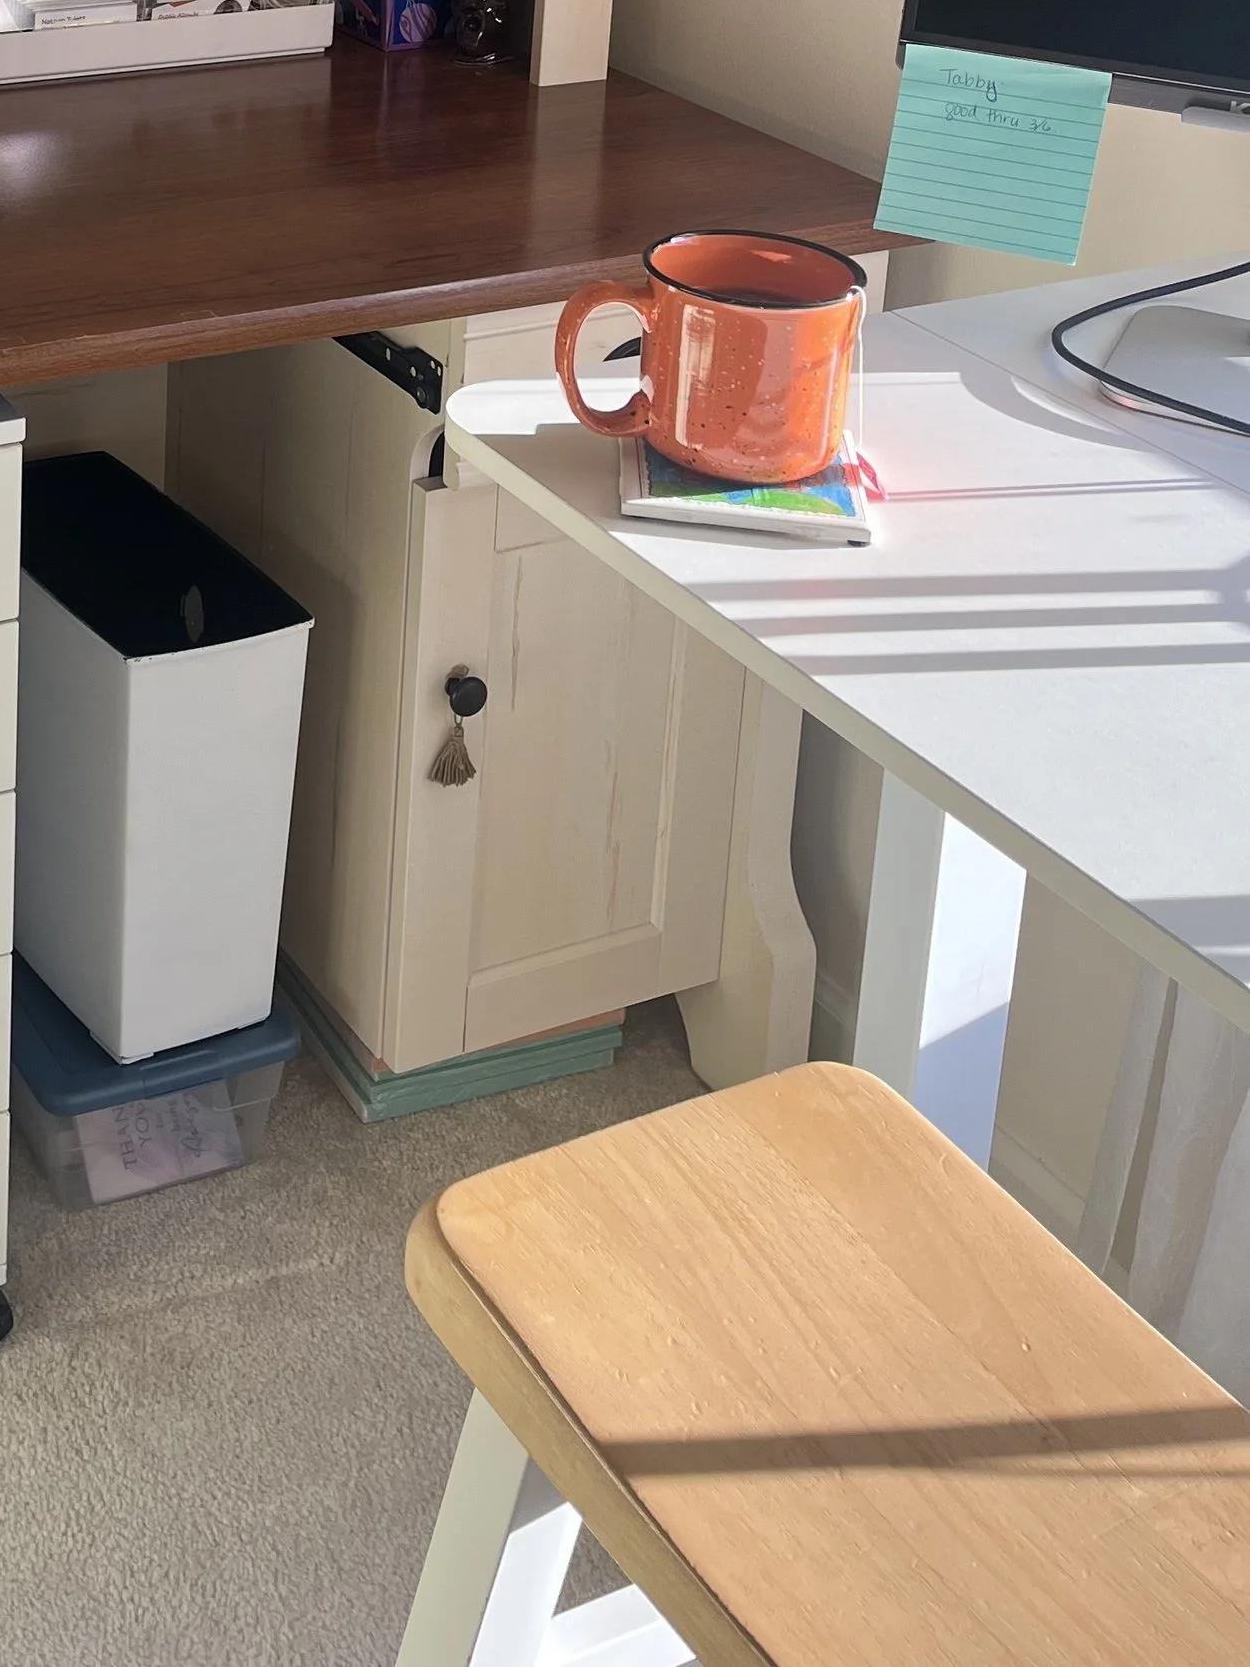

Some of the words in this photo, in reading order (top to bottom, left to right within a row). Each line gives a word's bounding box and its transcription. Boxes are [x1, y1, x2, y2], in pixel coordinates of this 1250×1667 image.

[944, 102, 978, 121] good
[987, 108, 1019, 127] thru
[112, 1106, 138, 1171] THAN
